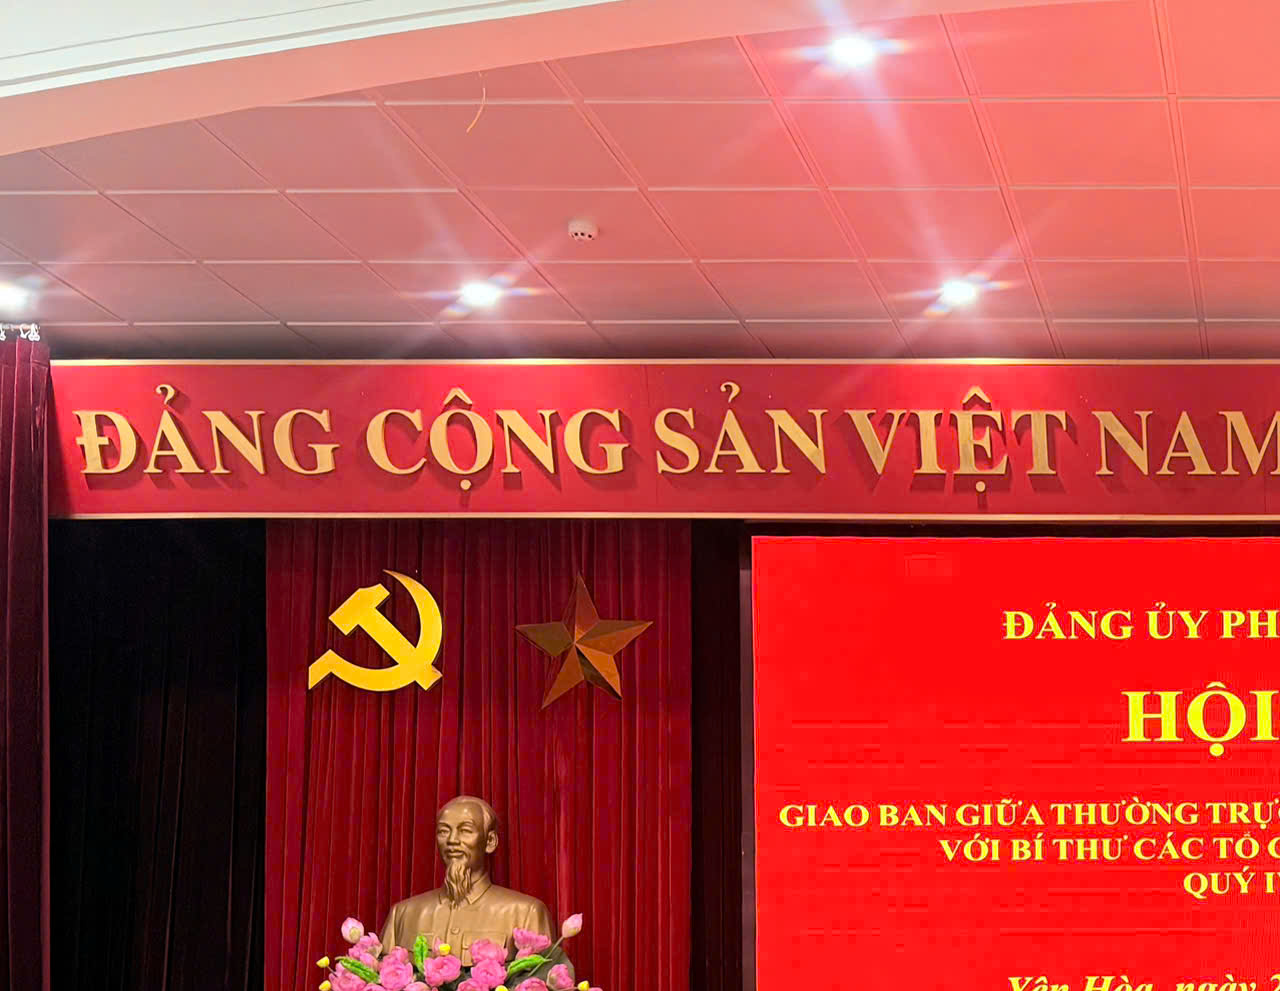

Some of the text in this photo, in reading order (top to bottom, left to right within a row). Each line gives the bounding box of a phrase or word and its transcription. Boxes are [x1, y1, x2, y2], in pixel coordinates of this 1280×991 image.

[76, 384, 338, 477] ĐẢNG
[366, 386, 630, 492] CỘNG
[655, 381, 829, 476] SẢN
[847, 386, 1068, 492] VIỆT
[1002, 602, 1134, 639] ĐẢNG
[1146, 601, 1209, 639] ỦY
[1121, 681, 1280, 757] HỘI
[779, 804, 870, 828] GIAO
[879, 804, 948, 827] BAN
[955, 798, 1045, 827] GIỮA
[1050, 796, 1199, 827] THƯỜNG
[939, 830, 1001, 862] VỚI
[1011, 830, 1044, 861] BÍ
[1053, 835, 1129, 861] THƯ
[1133, 830, 1204, 861] CÁC
[1212, 829, 1260, 859] TỔ
[1183, 866, 1256, 900] QUÝ
